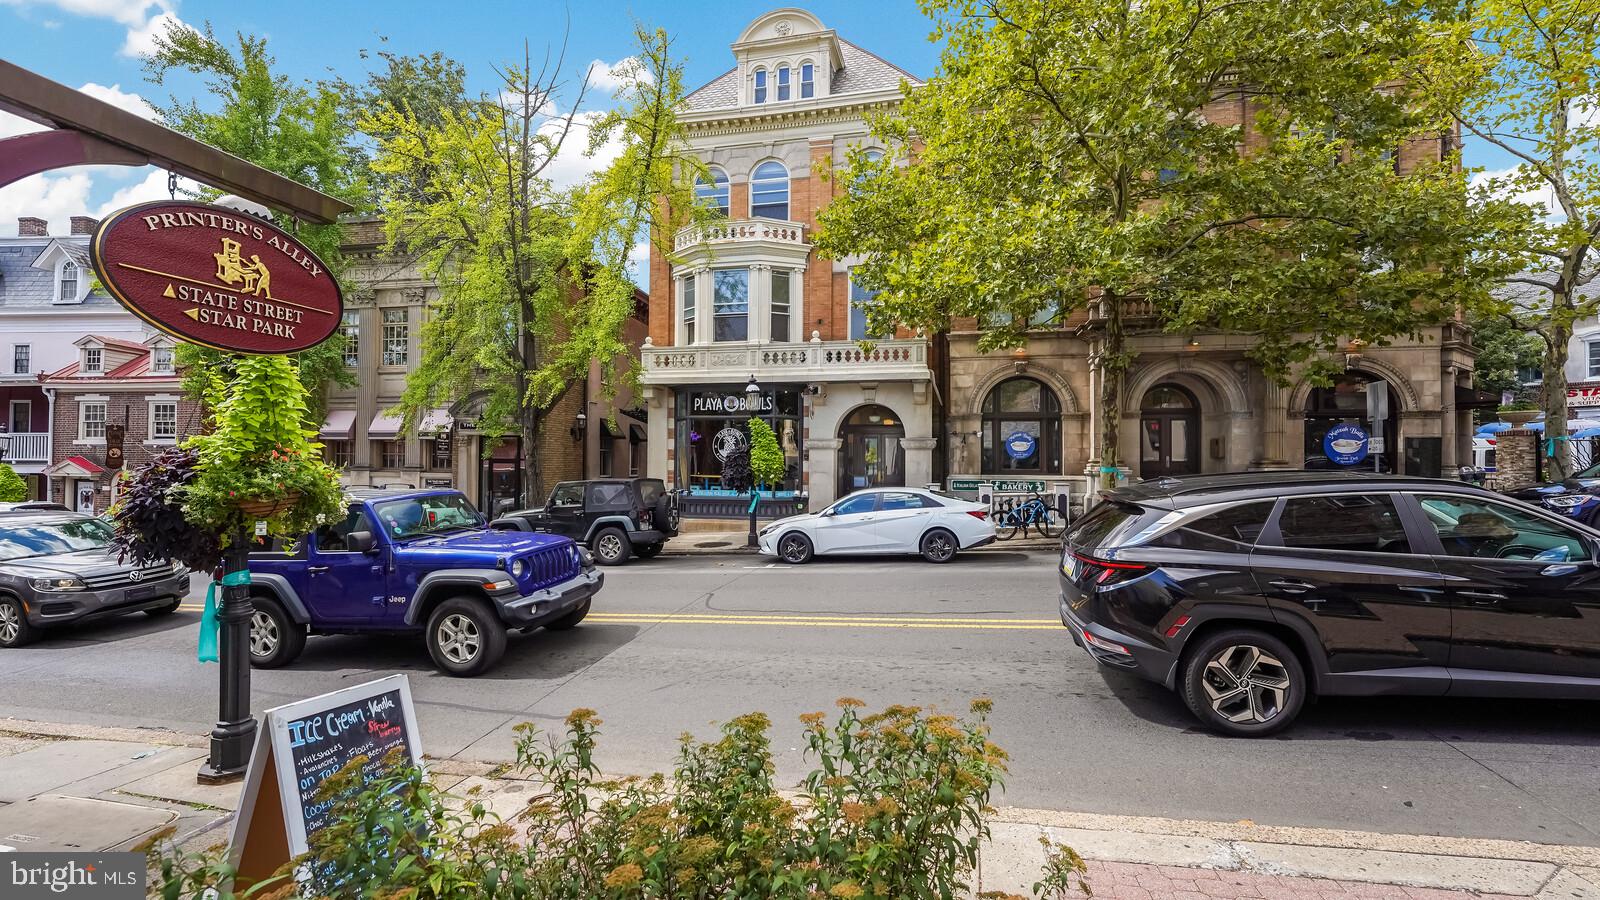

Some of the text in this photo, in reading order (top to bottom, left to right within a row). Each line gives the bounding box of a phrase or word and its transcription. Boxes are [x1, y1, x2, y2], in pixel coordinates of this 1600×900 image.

[143, 212, 323, 278] PRINTER'S ALLEY
[178, 285, 304, 324] STATE STREET
[199, 308, 296, 340] STAR PARK
[694, 396, 772, 411] PLAYA BLS
[388, 595, 406, 604] Jeep
